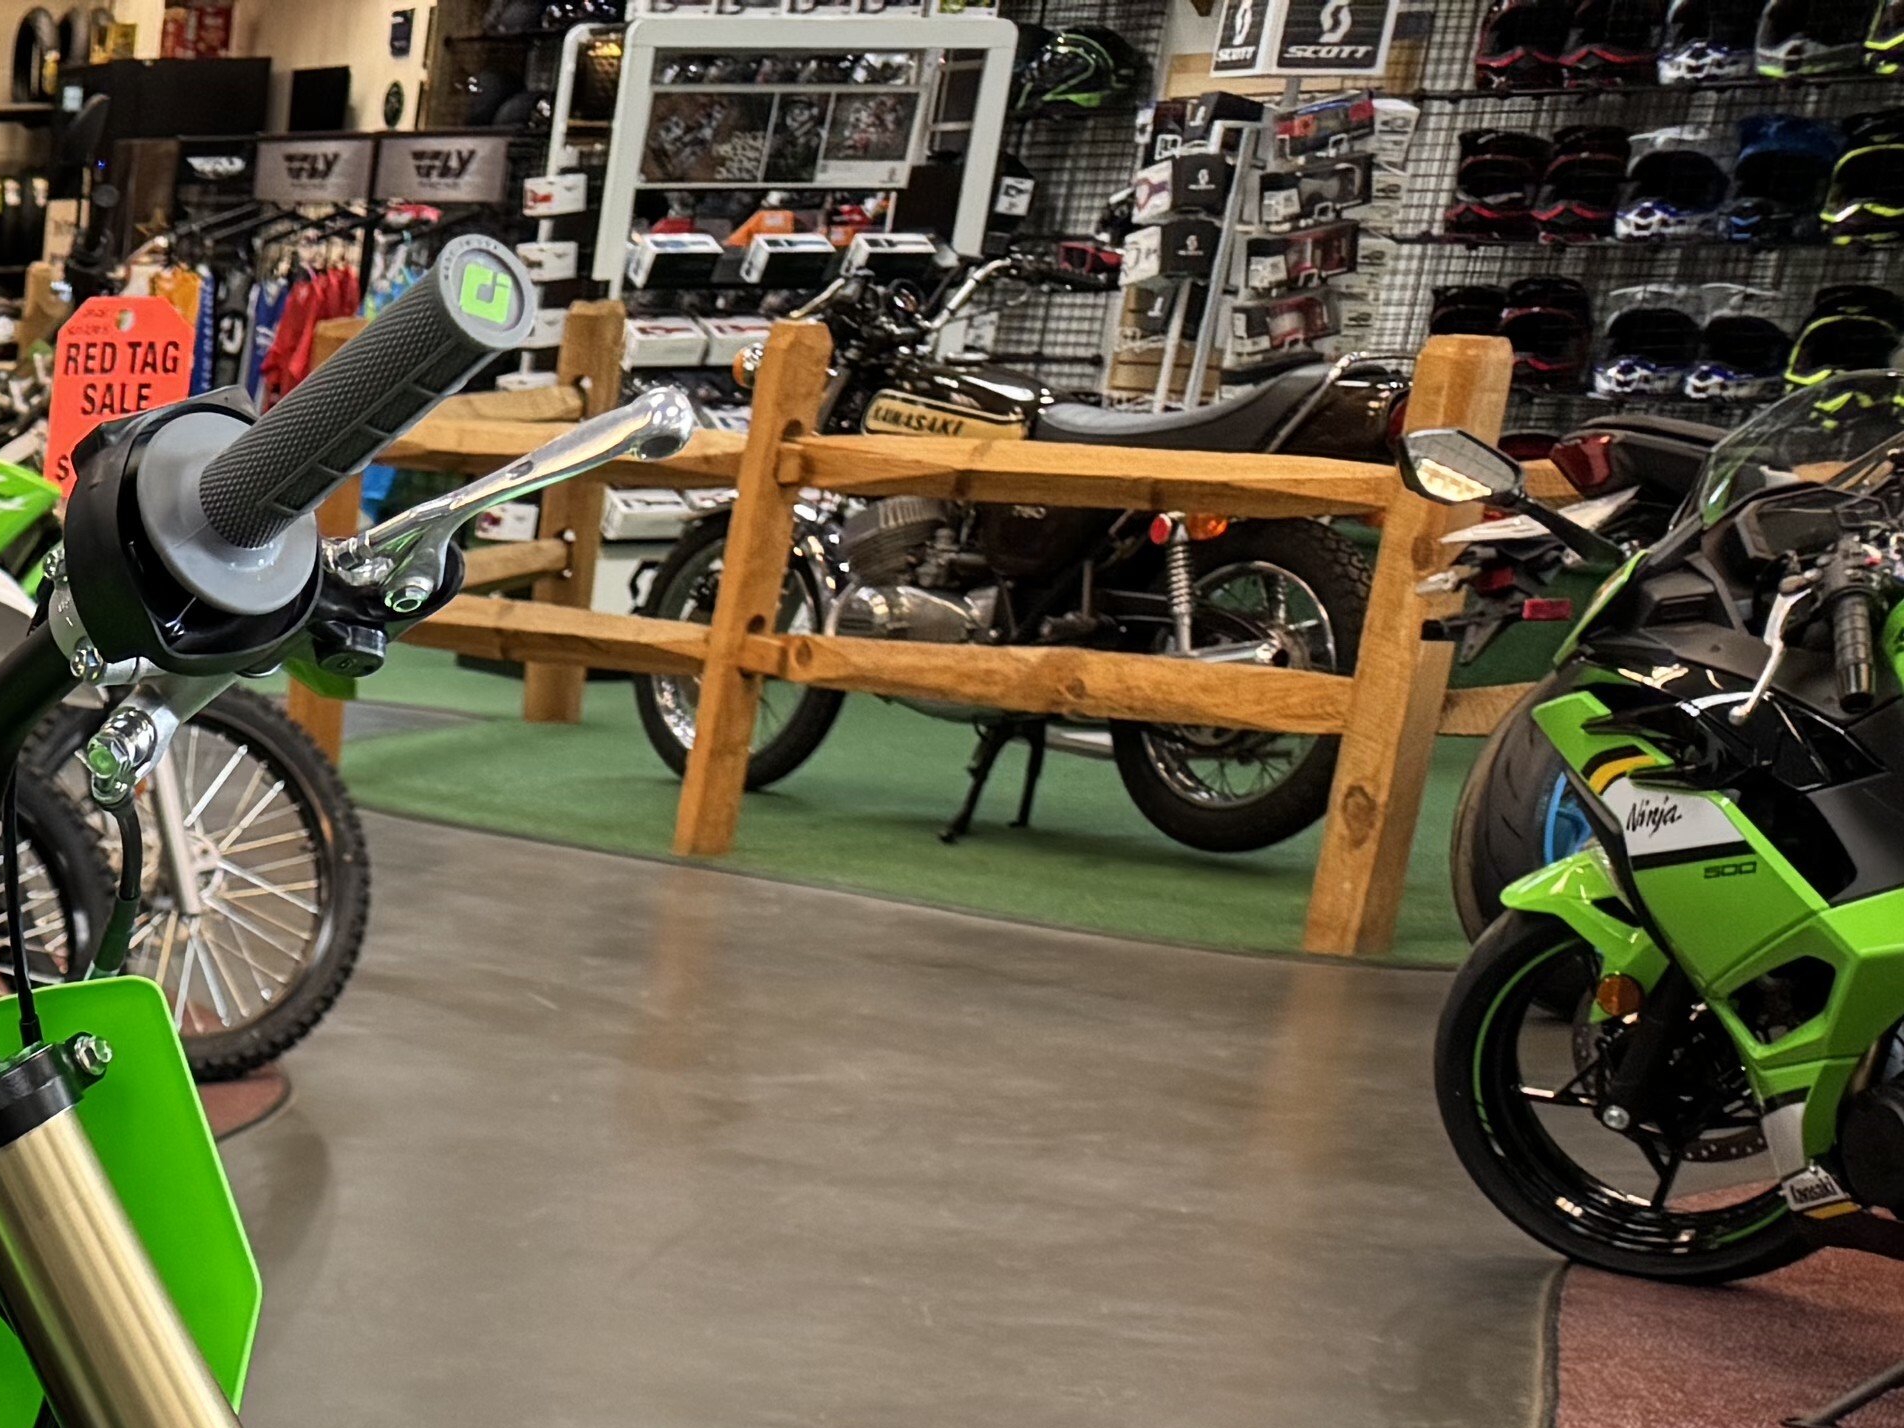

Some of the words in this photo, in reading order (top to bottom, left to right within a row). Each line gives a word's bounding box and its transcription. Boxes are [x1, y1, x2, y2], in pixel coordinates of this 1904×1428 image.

[1216, 45, 1256, 62] SCOTT
[1283, 45, 1373, 59] SCOTT
[283, 152, 340, 180] FLY
[411, 149, 476, 179] FLY
[63, 341, 117, 375] RED
[127, 340, 180, 374] TAG
[81, 383, 152, 415] SALE
[1626, 795, 1683, 838] Ninja
[1704, 861, 1757, 879] 500
